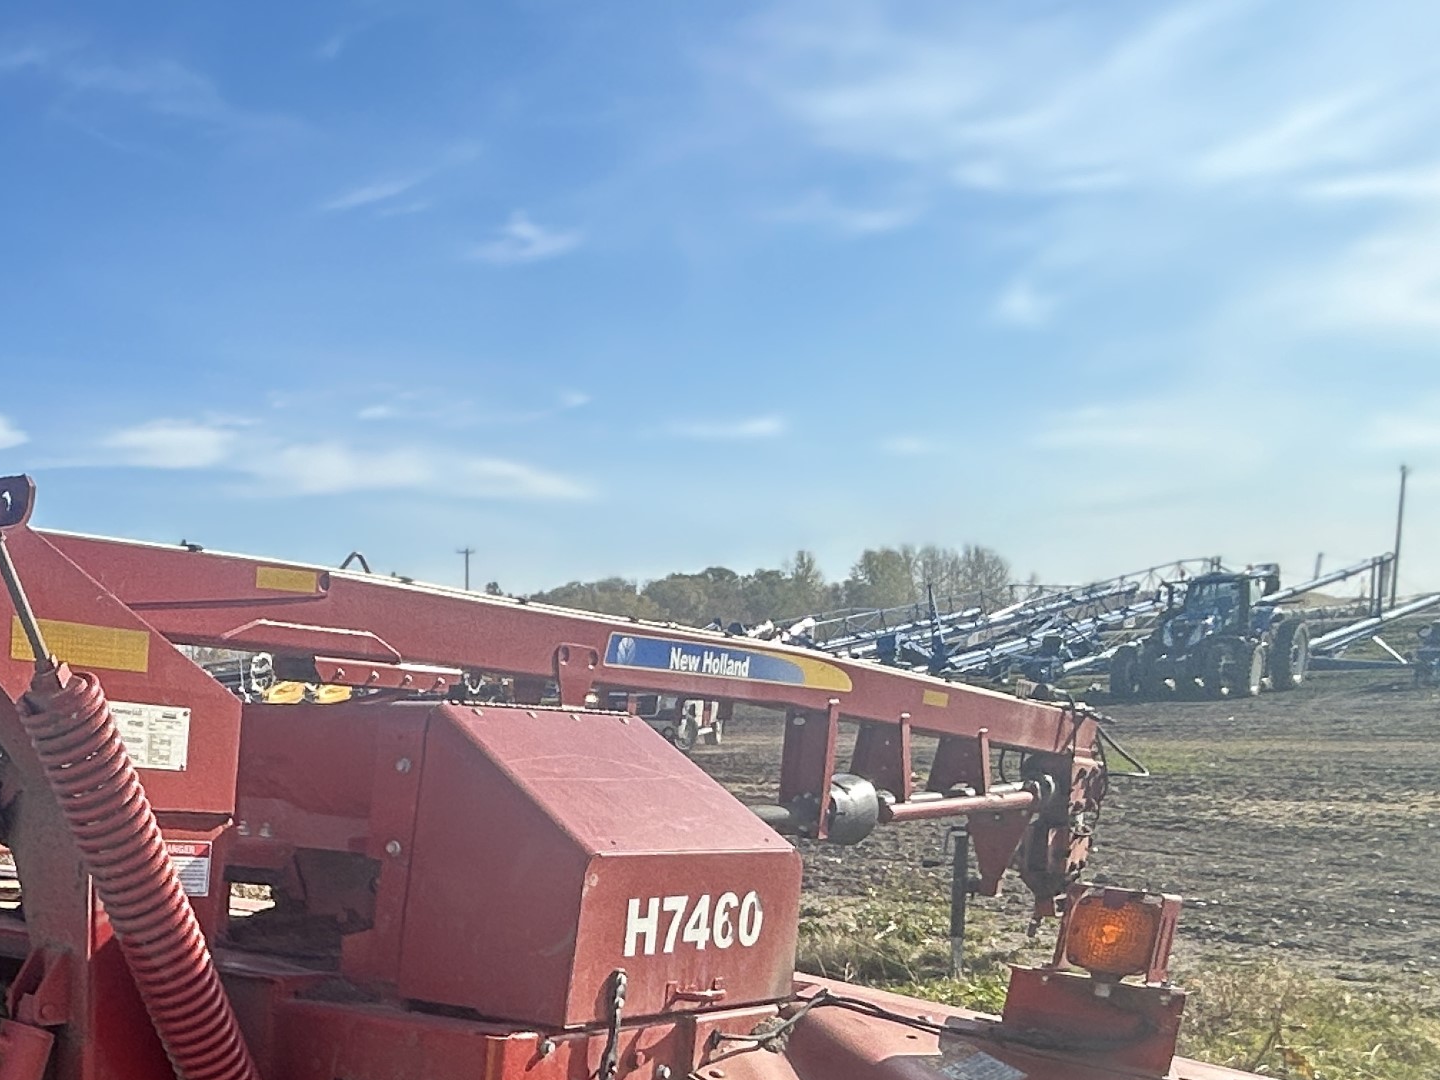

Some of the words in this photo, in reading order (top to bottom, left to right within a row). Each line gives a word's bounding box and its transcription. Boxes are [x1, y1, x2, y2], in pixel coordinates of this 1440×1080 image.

[669, 646, 700, 672] New
[701, 650, 751, 678] Holland
[623, 890, 763, 957] H7460
